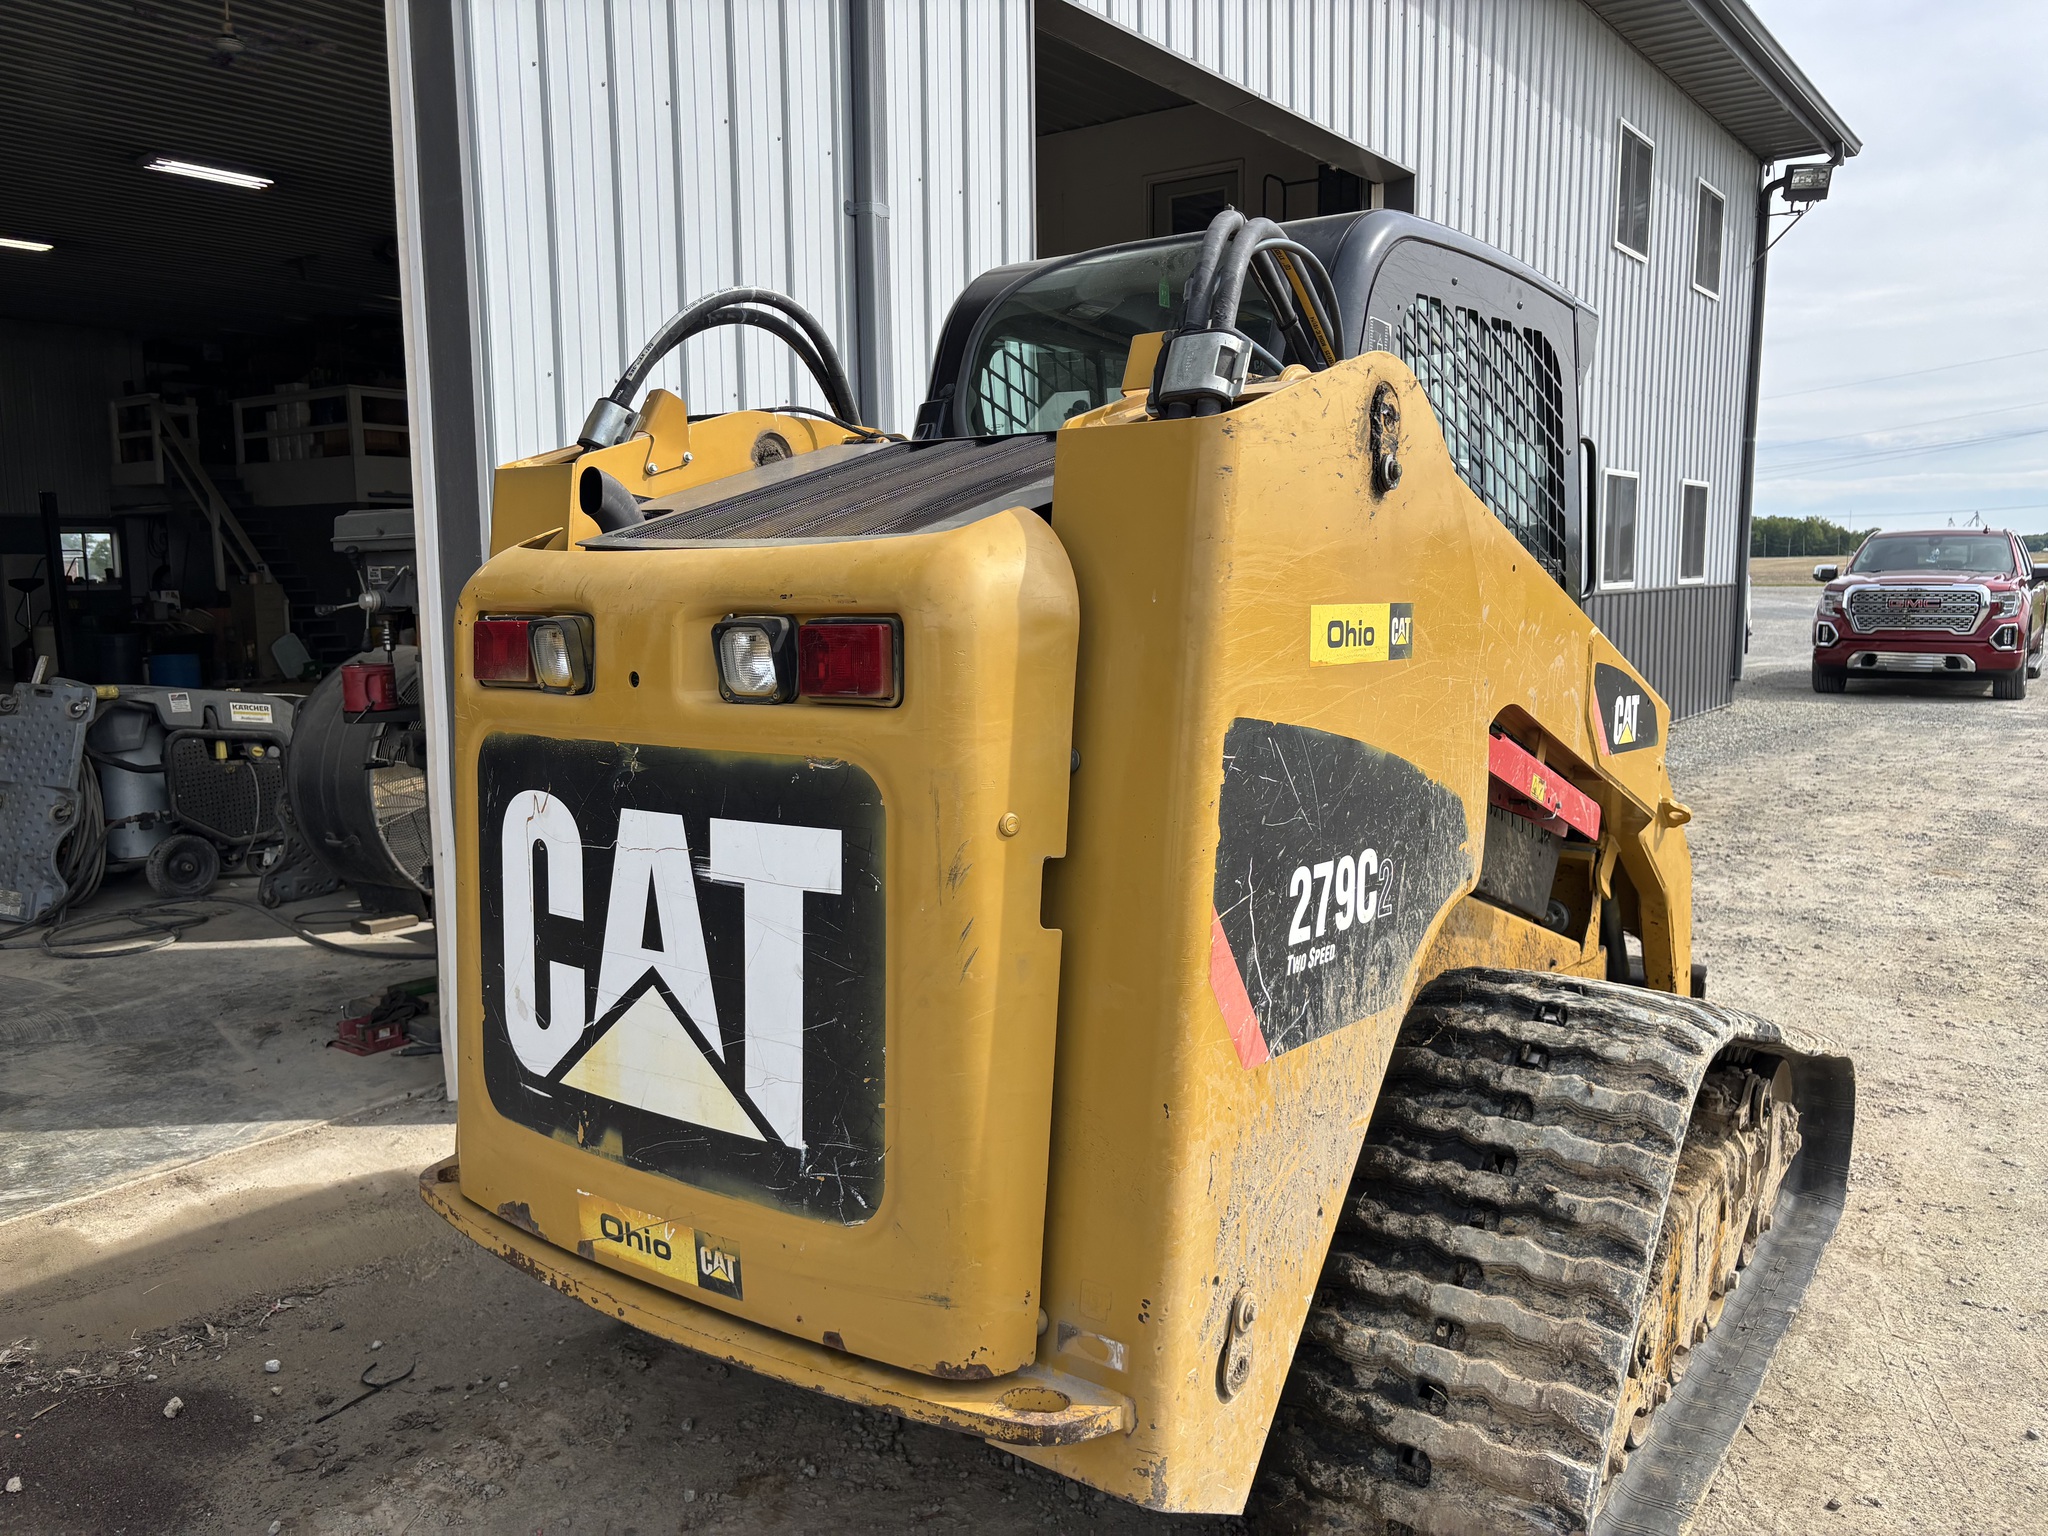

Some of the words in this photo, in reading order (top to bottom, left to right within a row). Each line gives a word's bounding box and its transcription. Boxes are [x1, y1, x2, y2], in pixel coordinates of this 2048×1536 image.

[1888, 598, 1941, 609] GMC
[1327, 619, 1375, 649] Ohio
[1391, 617, 1412, 645] CAT
[1613, 694, 1640, 746] CAT
[502, 789, 843, 1150] CAT
[600, 1212, 672, 1262] Ohio
[700, 1245, 736, 1285] CAT
